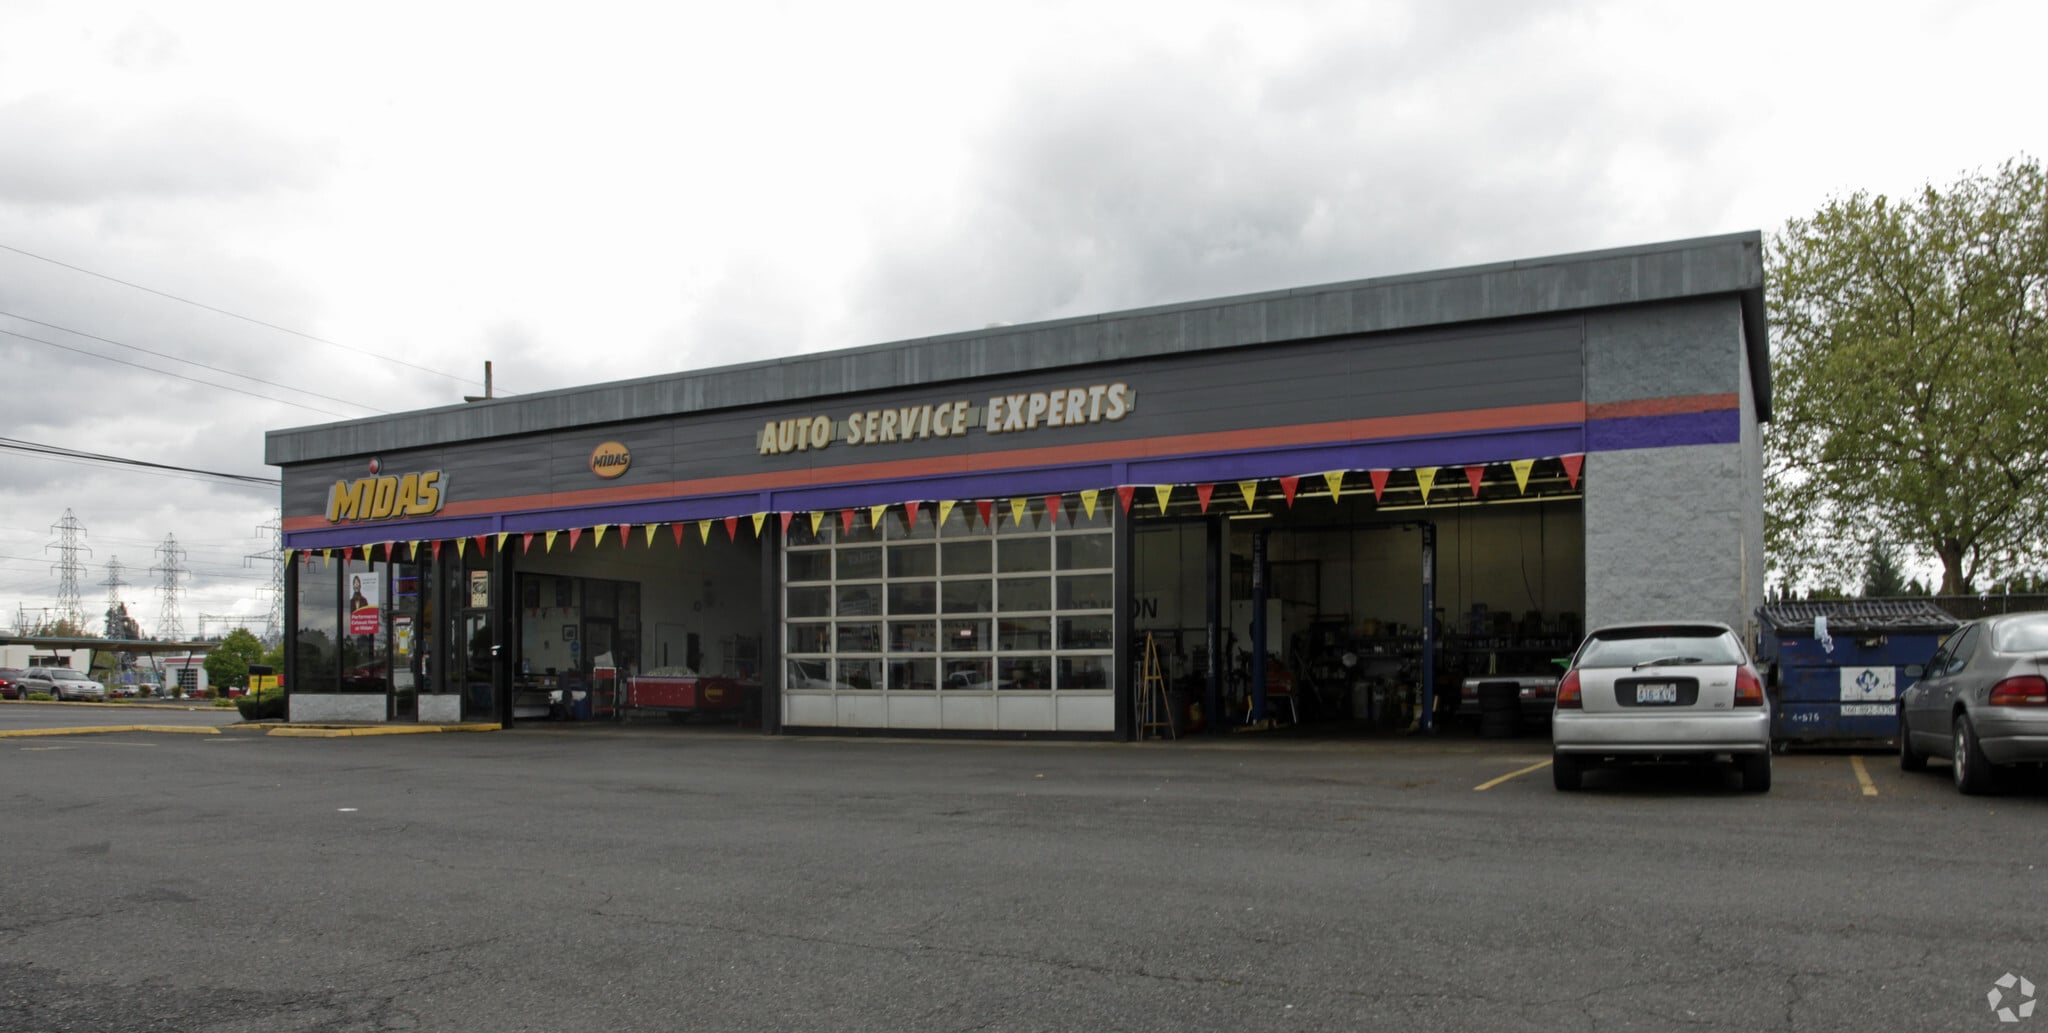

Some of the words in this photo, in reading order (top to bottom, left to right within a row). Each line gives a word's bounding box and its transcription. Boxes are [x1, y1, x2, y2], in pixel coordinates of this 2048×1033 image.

[759, 415, 832, 456] AUTO
[847, 400, 970, 445] SERVICE
[986, 382, 1129, 433] EXPERTS
[329, 456, 441, 523] MIDAS
[593, 449, 629, 468] MIDAS
